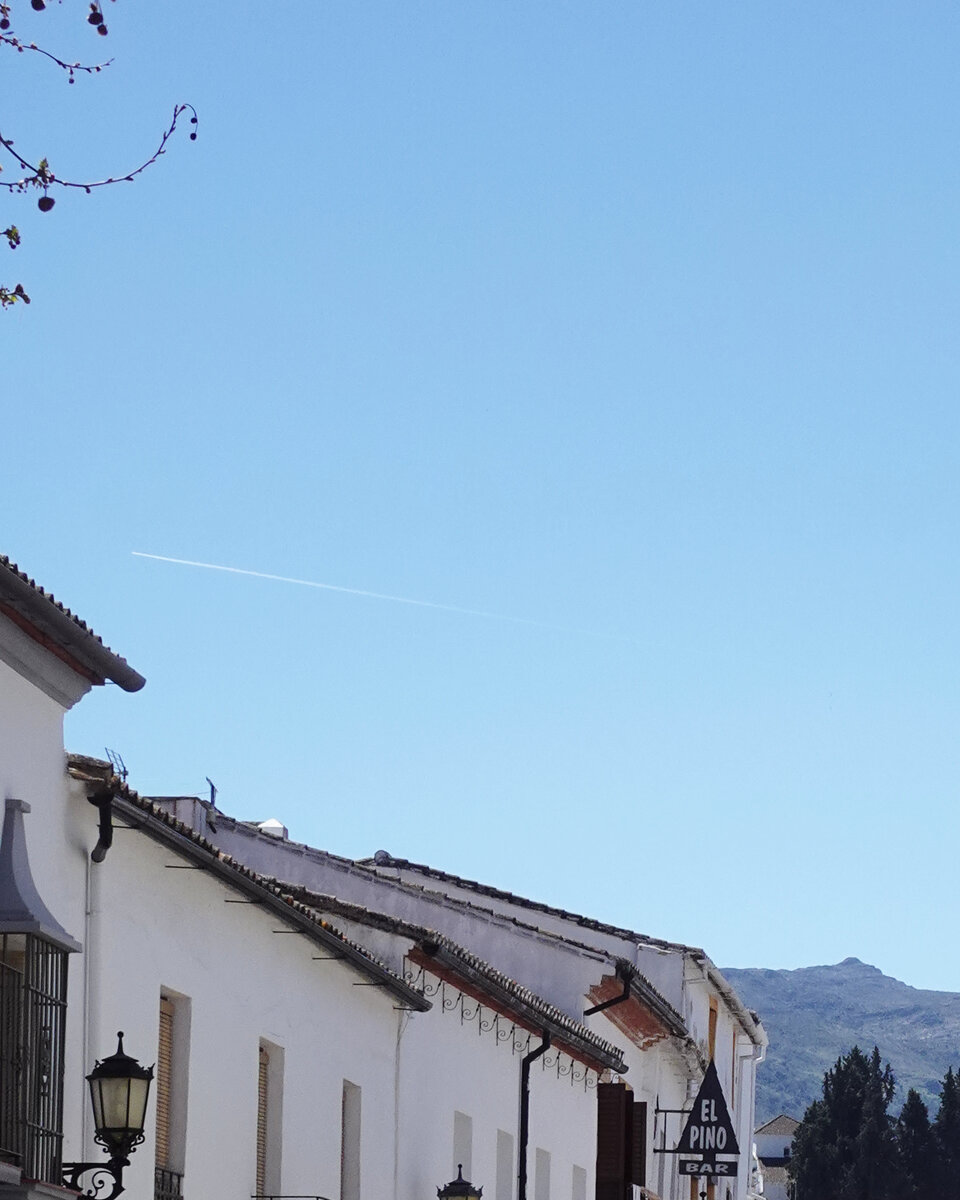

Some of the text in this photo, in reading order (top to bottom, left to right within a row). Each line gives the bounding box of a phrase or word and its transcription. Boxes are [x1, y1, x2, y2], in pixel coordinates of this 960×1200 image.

[701, 1099, 718, 1122] EL
[689, 1125, 727, 1150] PINO
[685, 1162, 729, 1174] BAR
